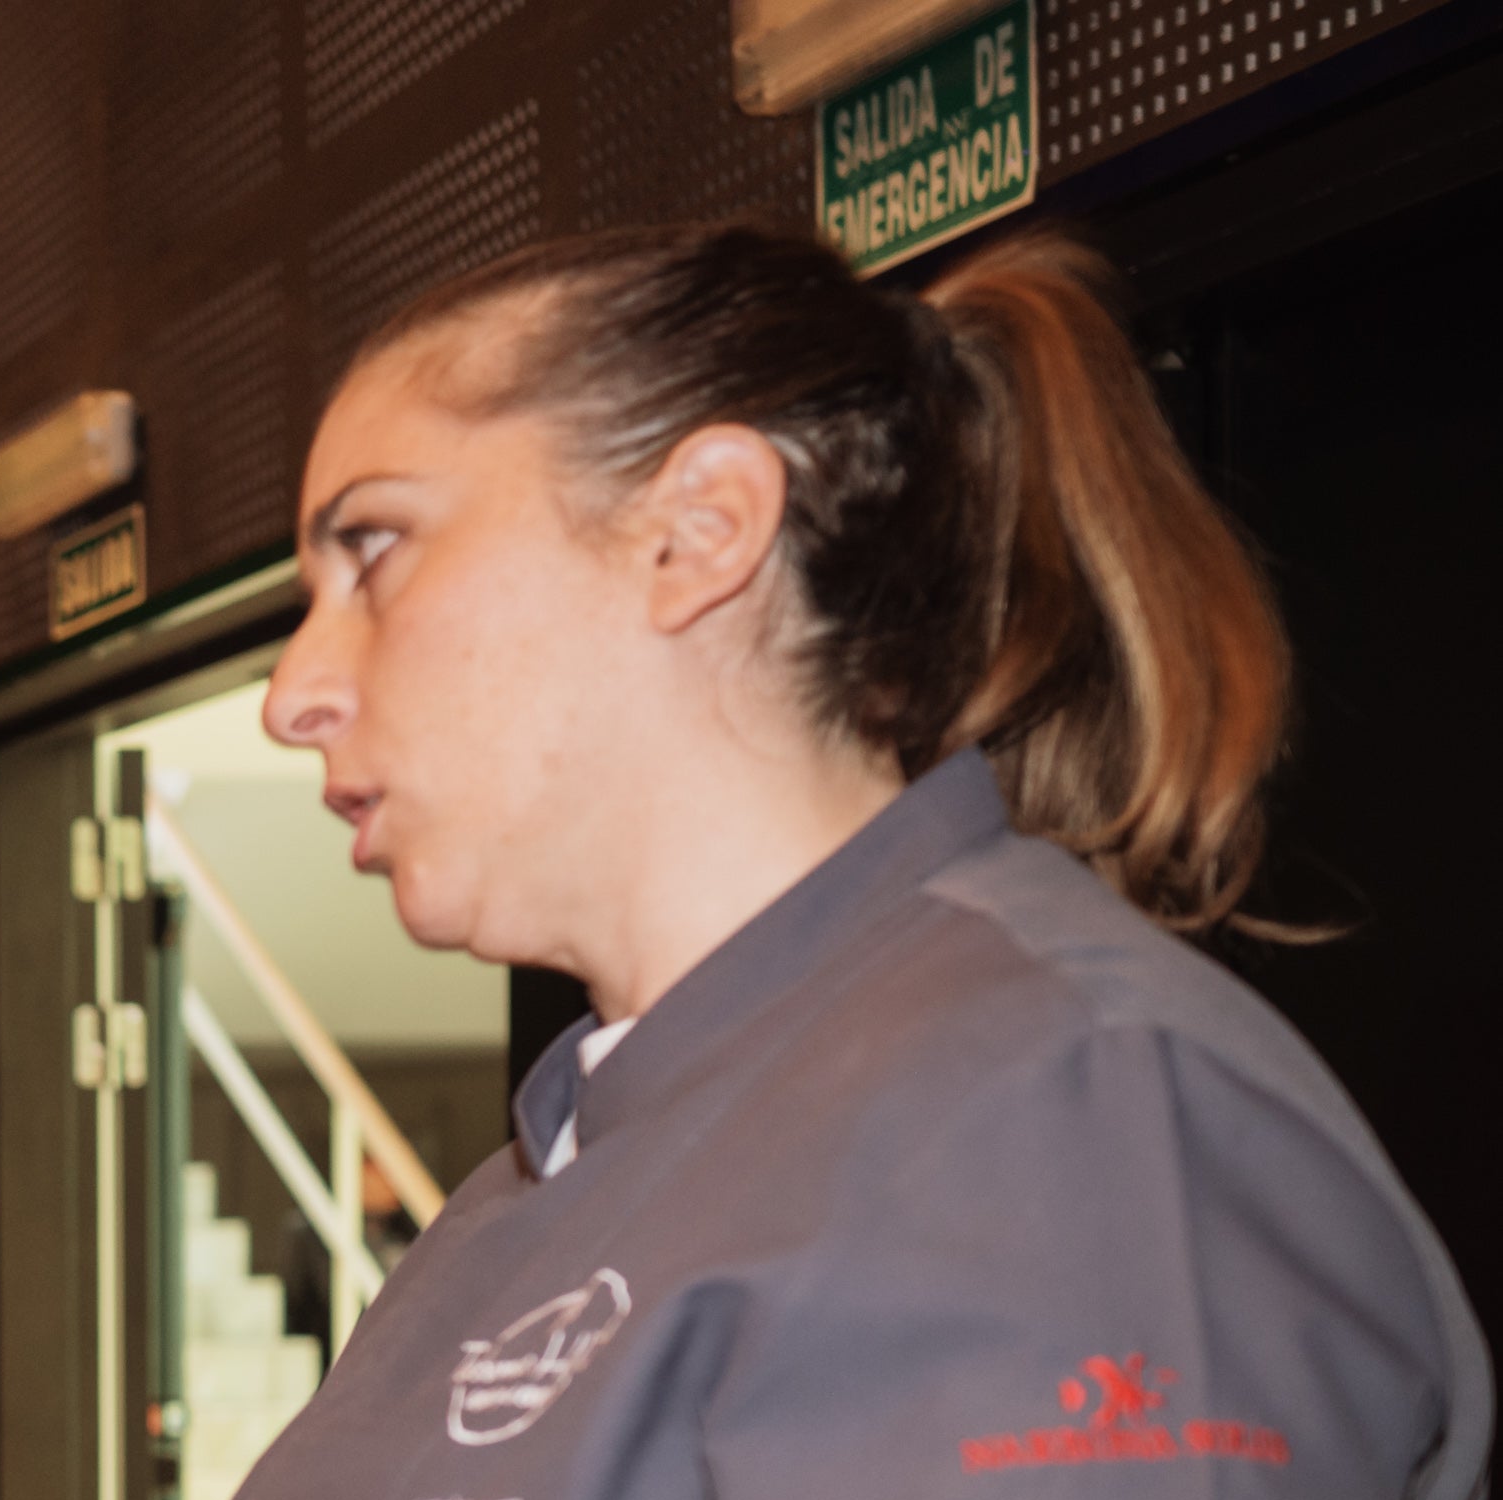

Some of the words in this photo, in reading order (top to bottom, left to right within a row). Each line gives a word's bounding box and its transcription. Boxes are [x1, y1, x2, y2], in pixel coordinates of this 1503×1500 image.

[835, 65, 937, 179] SALIDA
[975, 21, 1016, 108] DE
[826, 113, 1024, 256] EMERGENCIA
